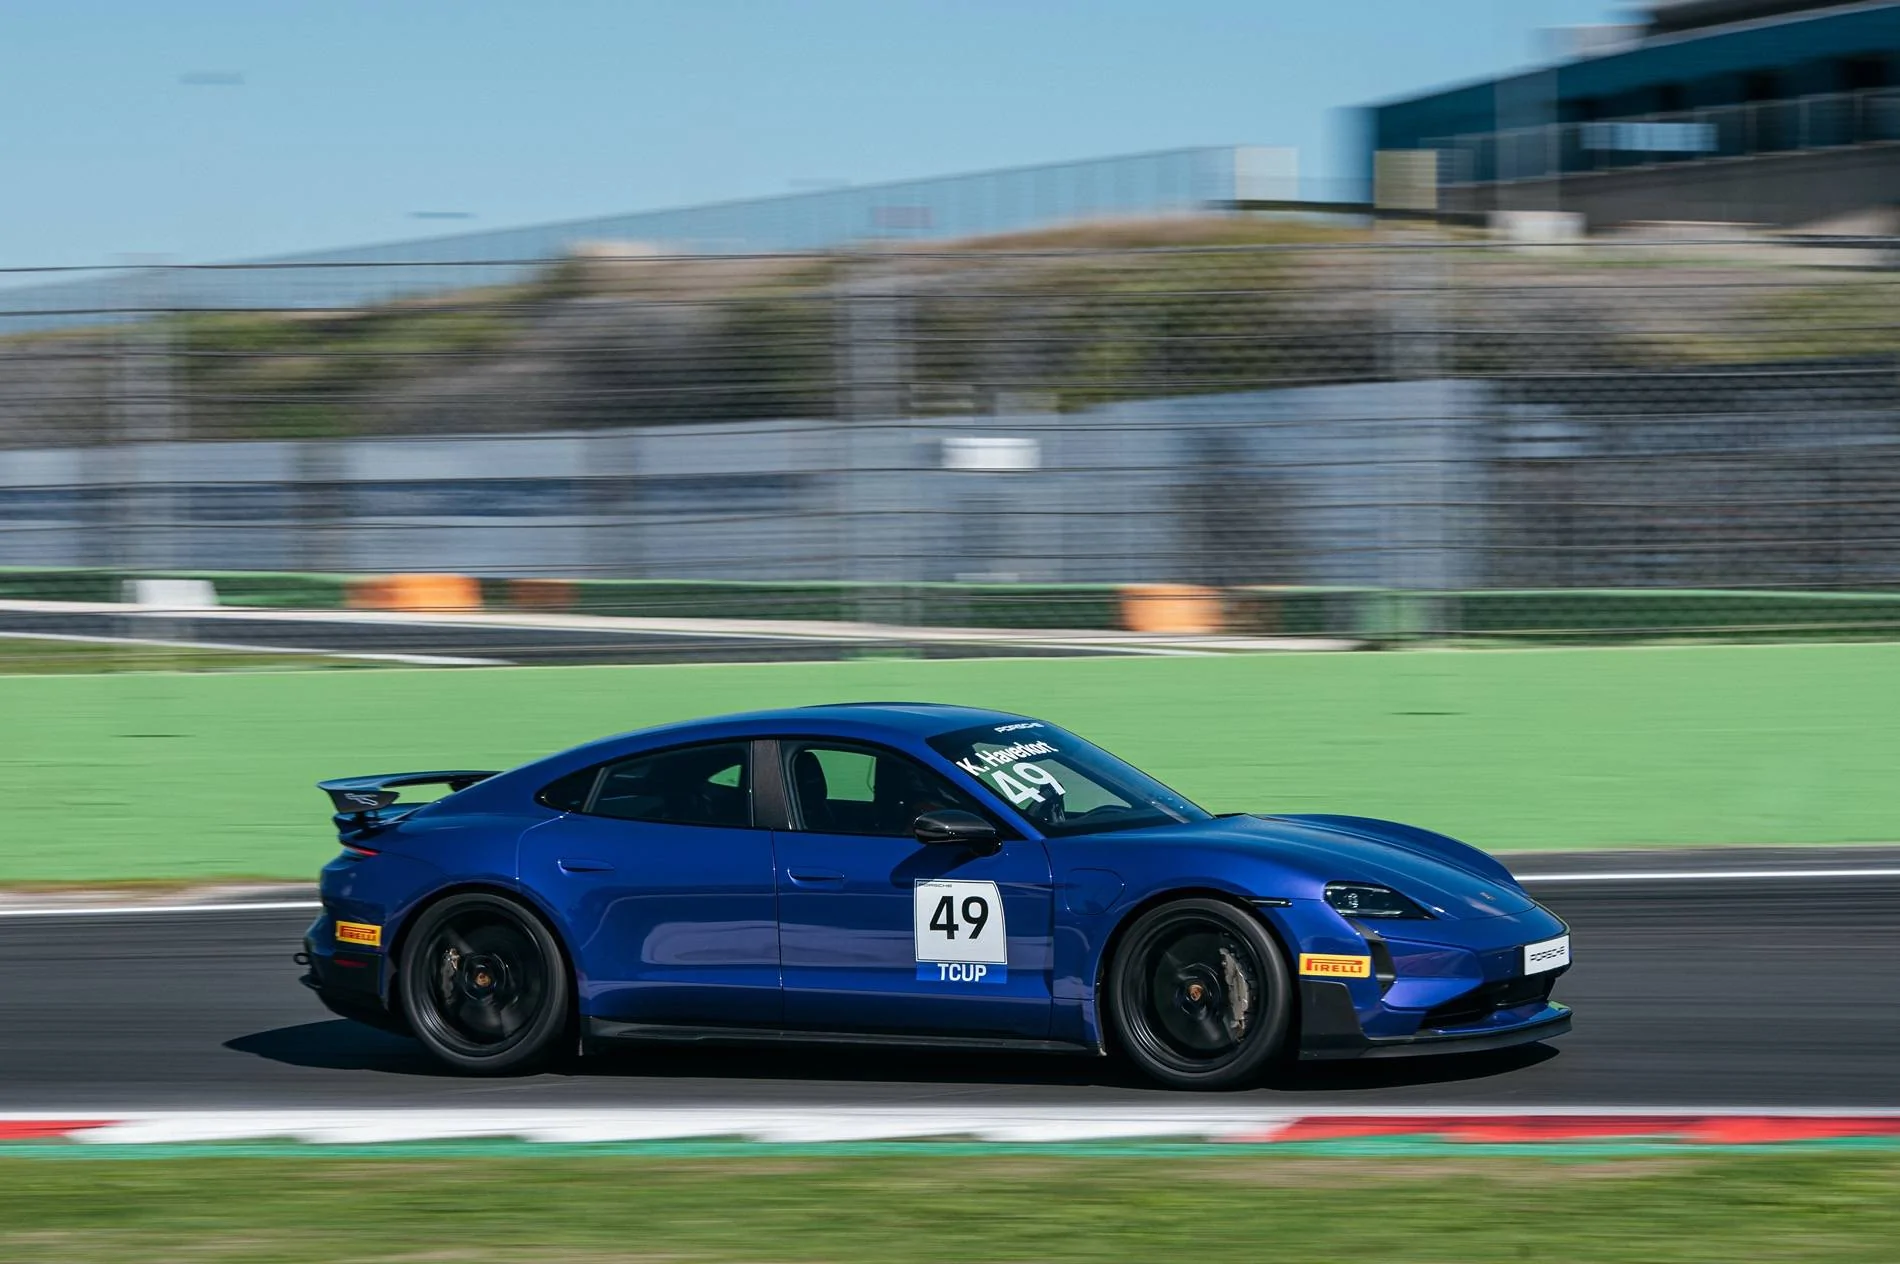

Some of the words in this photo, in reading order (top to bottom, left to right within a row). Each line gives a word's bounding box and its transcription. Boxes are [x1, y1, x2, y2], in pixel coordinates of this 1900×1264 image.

[956, 757, 990, 777] K.
[975, 740, 1060, 767] Haverkort
[991, 762, 1066, 804] 49
[929, 895, 989, 940] 49
[1306, 958, 1363, 973] PIRELLI
[1529, 945, 1565, 961] PORSCHE
[937, 963, 987, 982] TCUP
